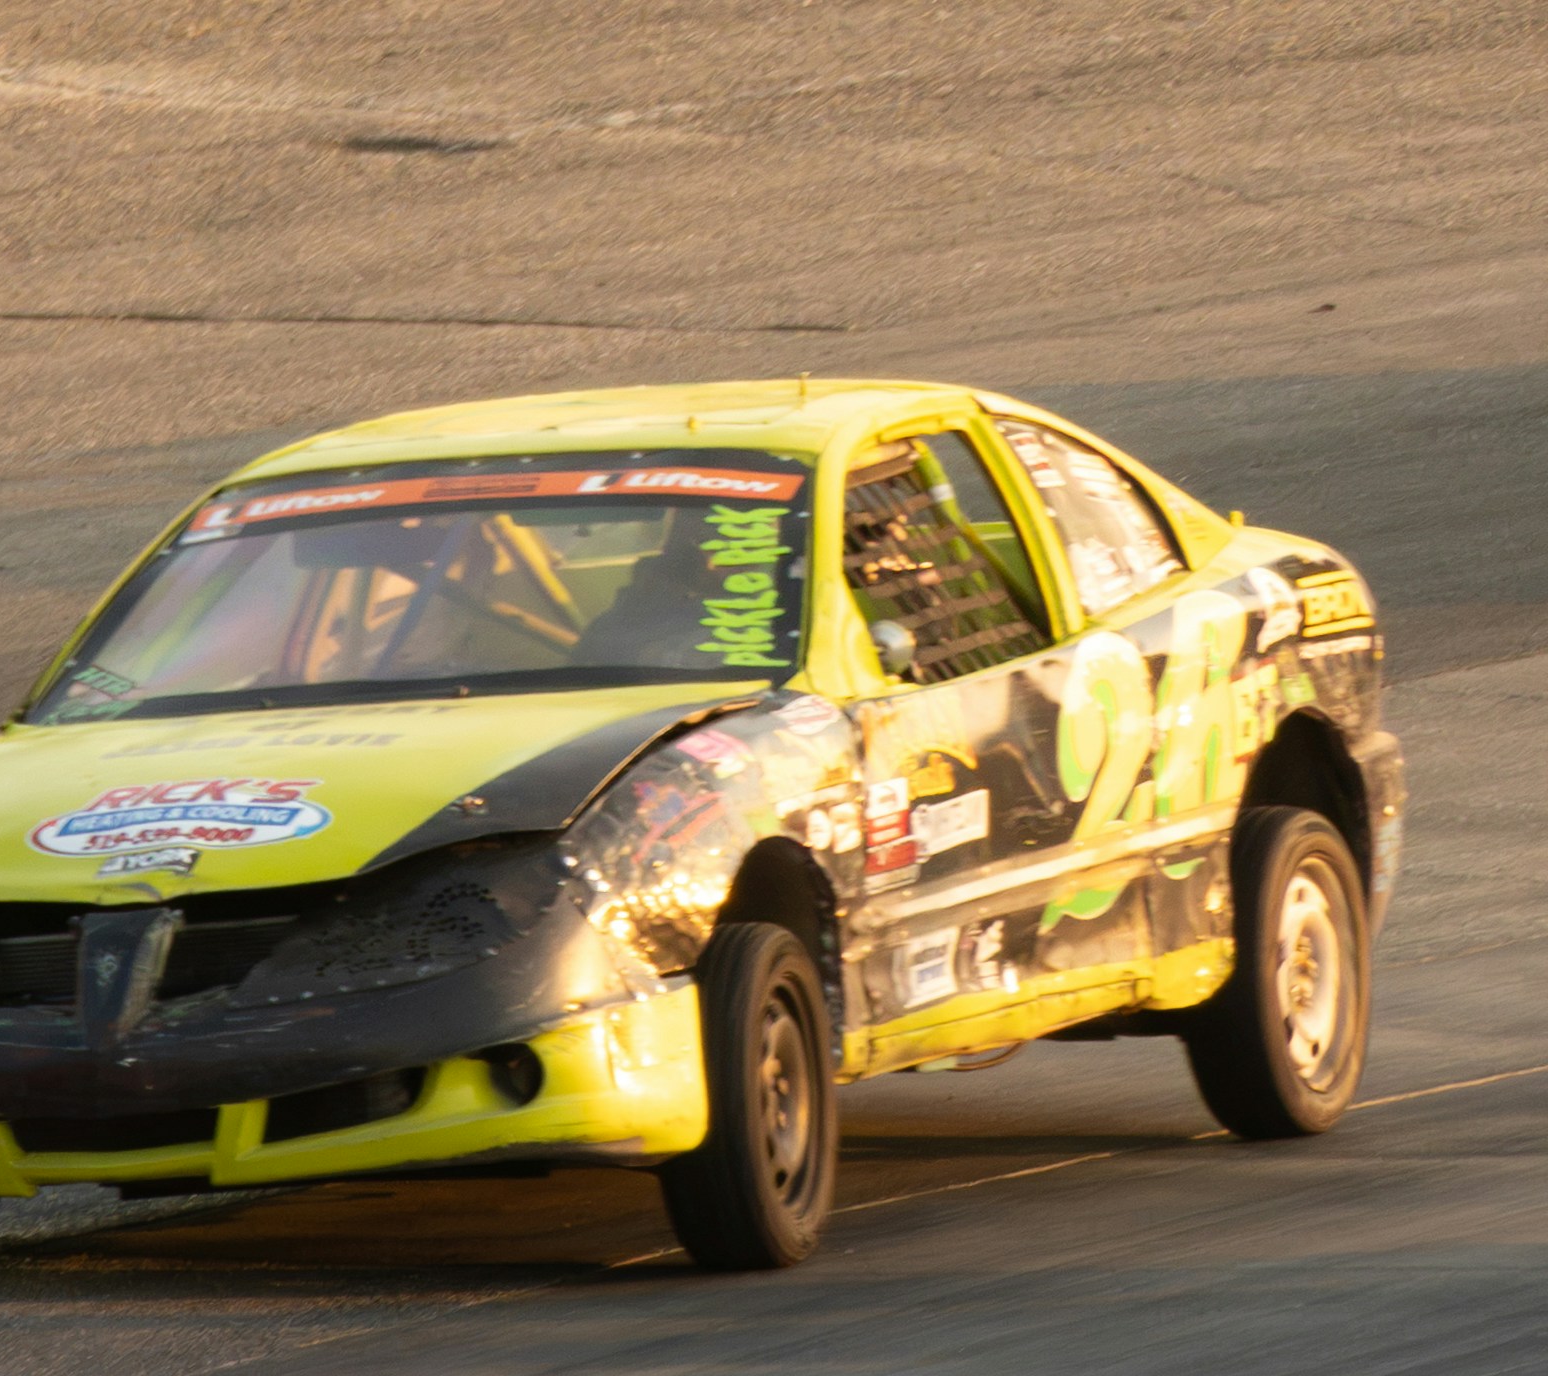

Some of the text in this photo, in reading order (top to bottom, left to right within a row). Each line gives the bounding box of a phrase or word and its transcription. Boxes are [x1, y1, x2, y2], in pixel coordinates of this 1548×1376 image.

[627, 471, 778, 497] Liftow
[248, 489, 385, 518] Liftow
[87, 780, 321, 811] RICK'S
[182, 807, 292, 824] COOLING
